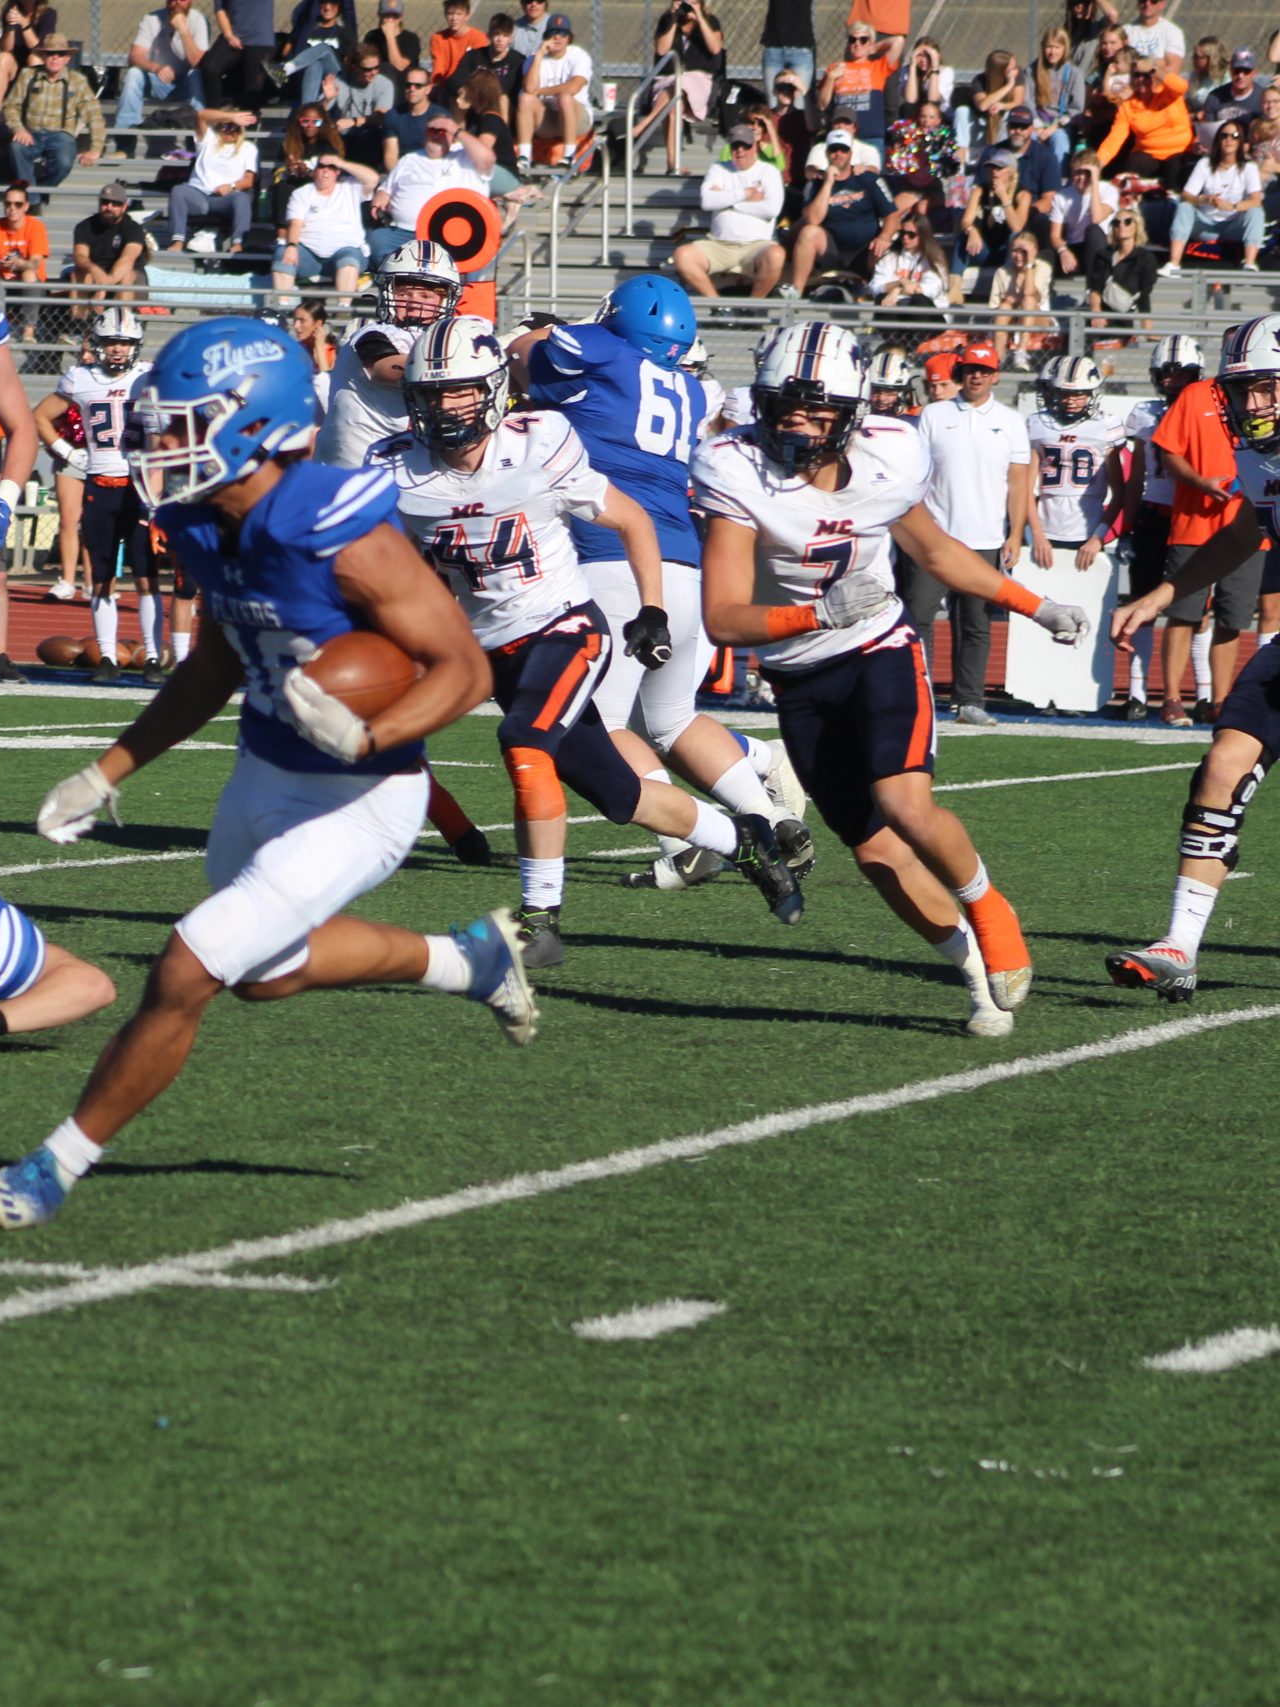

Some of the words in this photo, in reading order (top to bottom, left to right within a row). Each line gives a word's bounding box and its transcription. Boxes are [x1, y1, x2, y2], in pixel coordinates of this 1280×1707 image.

[201, 339, 285, 382] Flyers
[634, 358, 691, 465] 61
[1059, 434, 1078, 444] MC
[450, 502, 485, 519] MC
[813, 519, 854, 538] MC
[429, 512, 543, 592] 44
[801, 534, 859, 601] 7
